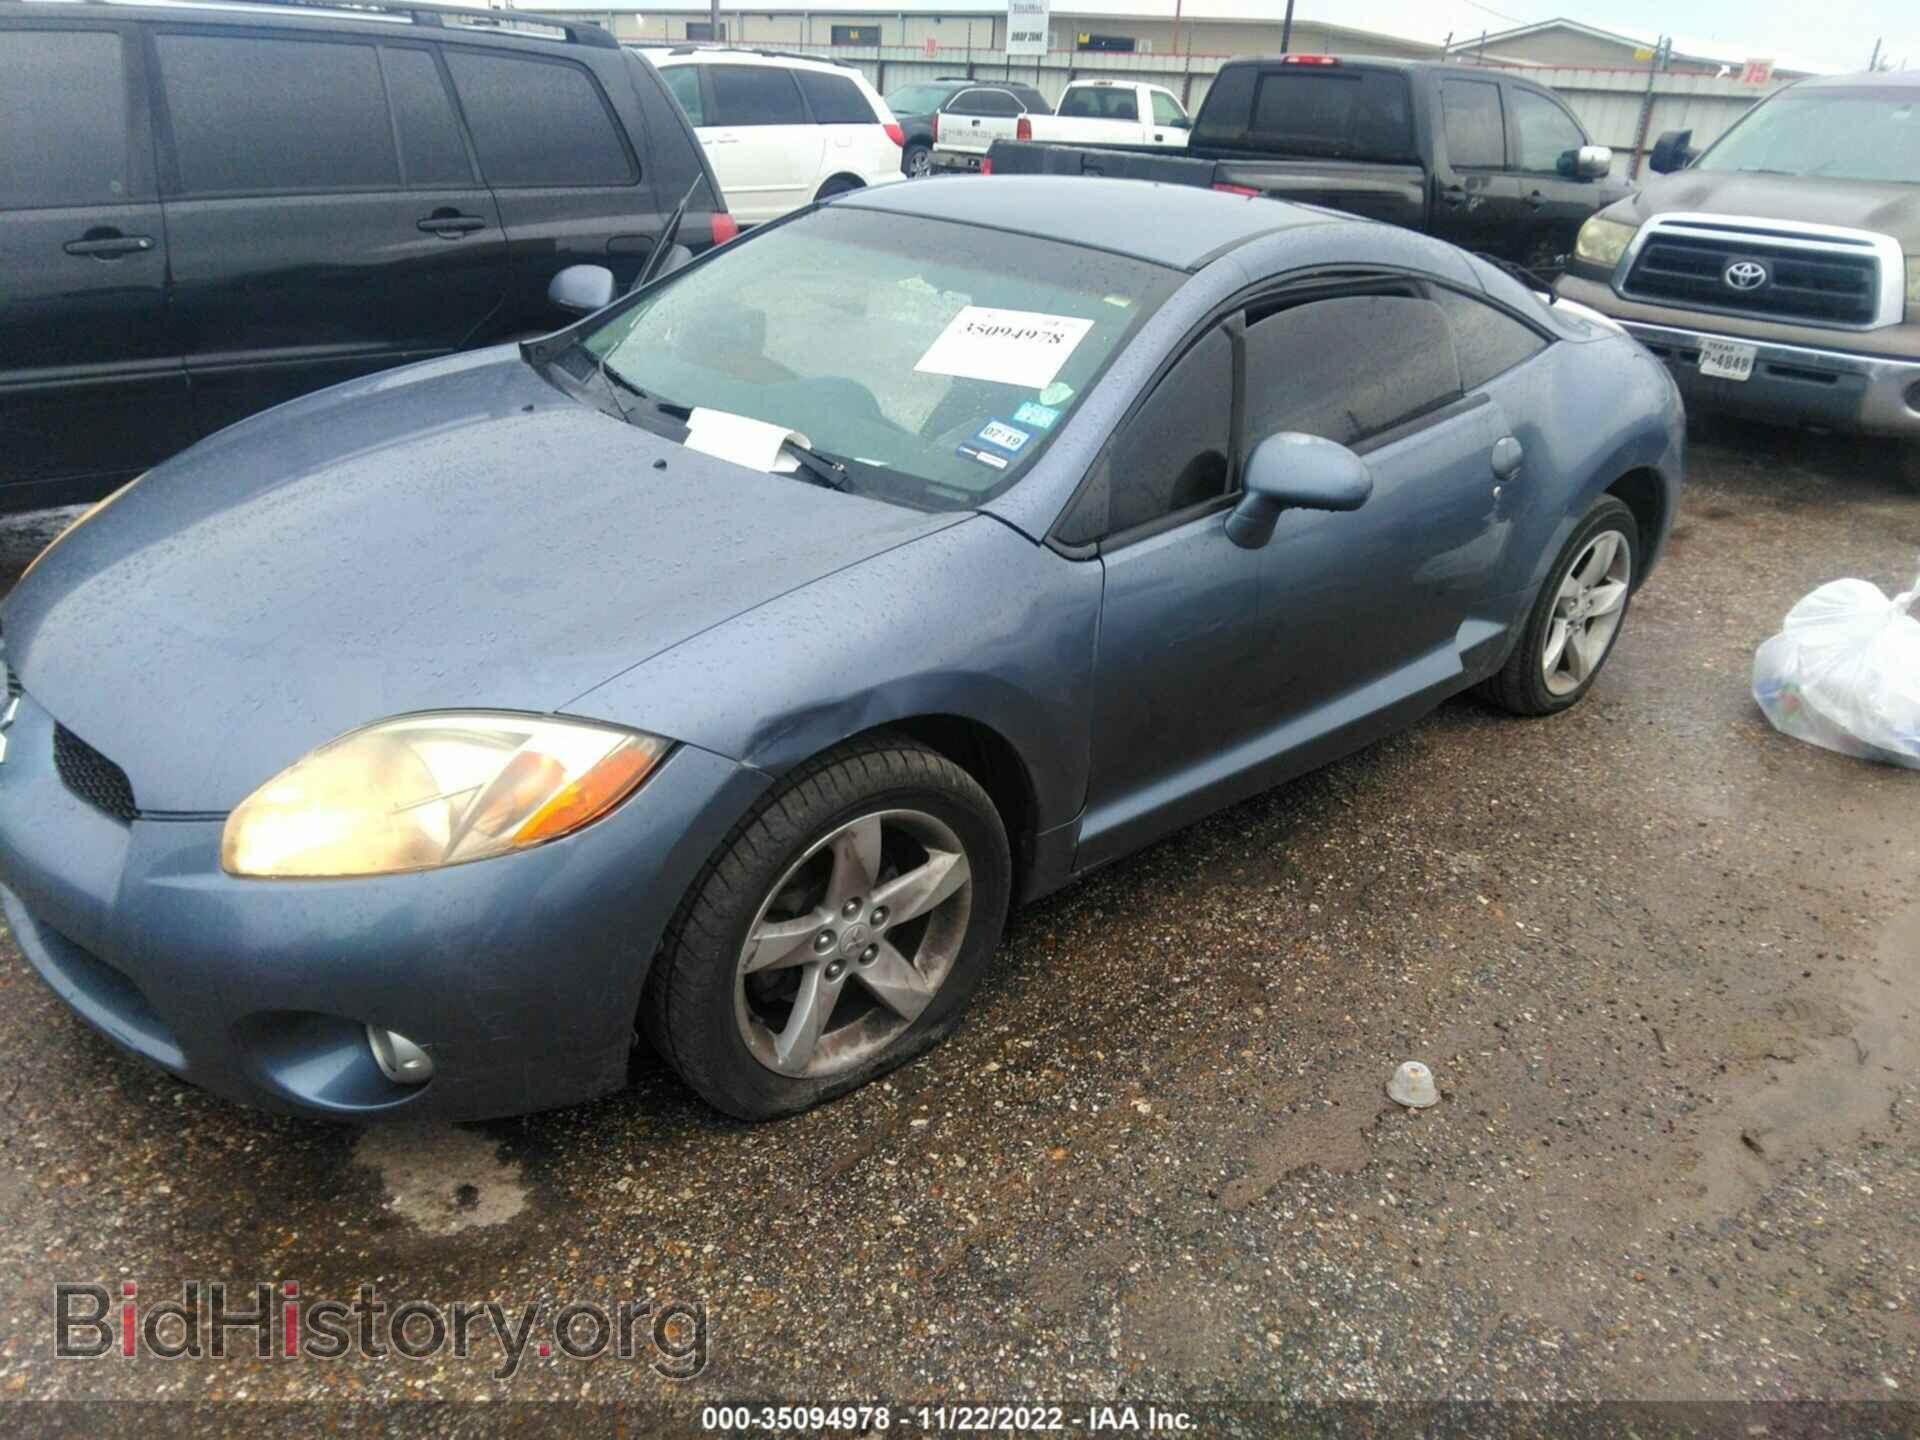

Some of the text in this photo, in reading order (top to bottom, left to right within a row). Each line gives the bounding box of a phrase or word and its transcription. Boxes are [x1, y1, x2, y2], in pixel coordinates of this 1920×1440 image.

[1011, 31, 1043, 42] DROP ZONE
[966, 321, 1065, 344] 35094978
